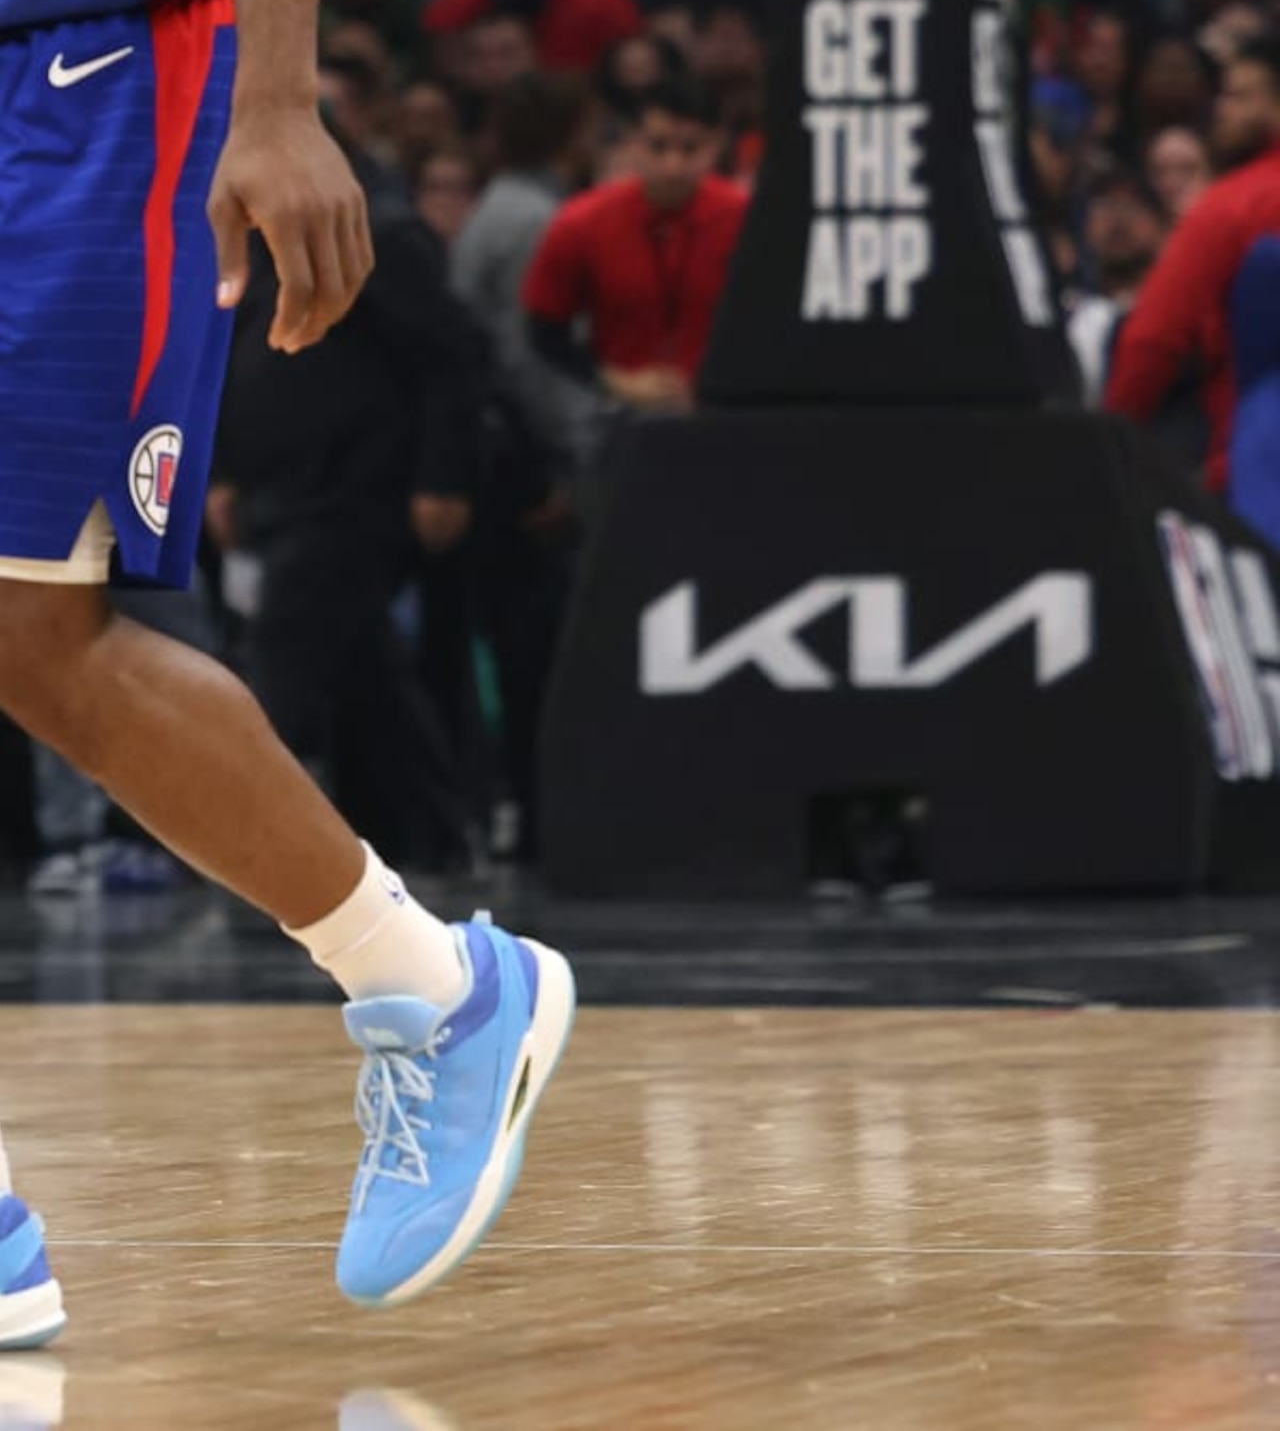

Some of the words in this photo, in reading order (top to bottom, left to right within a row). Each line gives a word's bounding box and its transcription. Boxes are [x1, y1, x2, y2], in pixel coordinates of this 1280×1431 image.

[801, 103, 930, 210] THE
[801, 215, 932, 320] APP
[640, 570, 1091, 695] KIA
